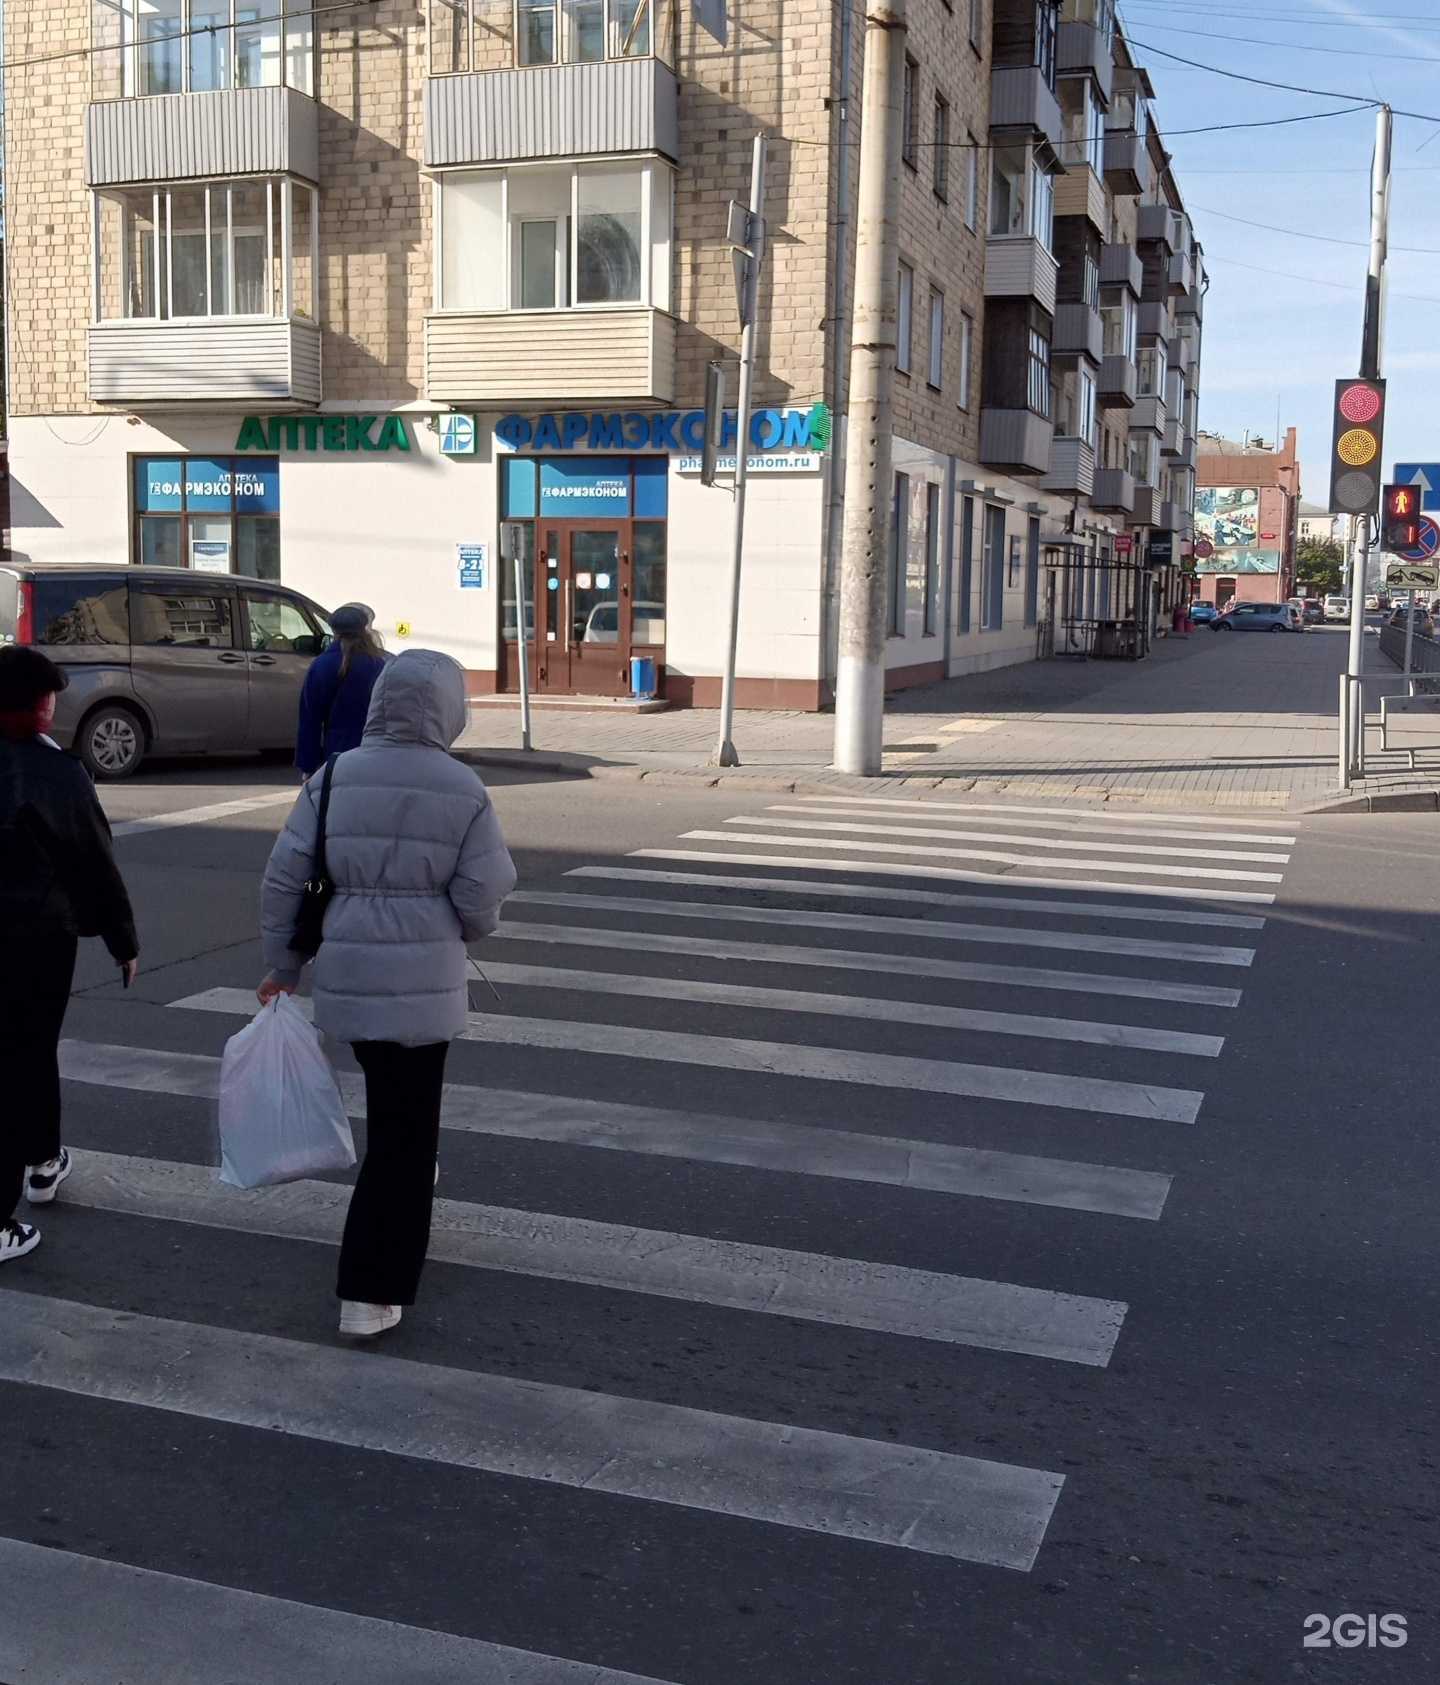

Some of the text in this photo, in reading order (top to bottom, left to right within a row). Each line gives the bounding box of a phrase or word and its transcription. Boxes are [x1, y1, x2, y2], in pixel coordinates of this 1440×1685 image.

[235, 415, 411, 451] АПТЕКА
[680, 457, 810, 470] phameonom.ru
[218, 474, 258, 482] АПТЕКА
[161, 482, 265, 496] ФАРМЭКОНОМ
[551, 487, 627, 497] ФАРМЭКОНОМ
